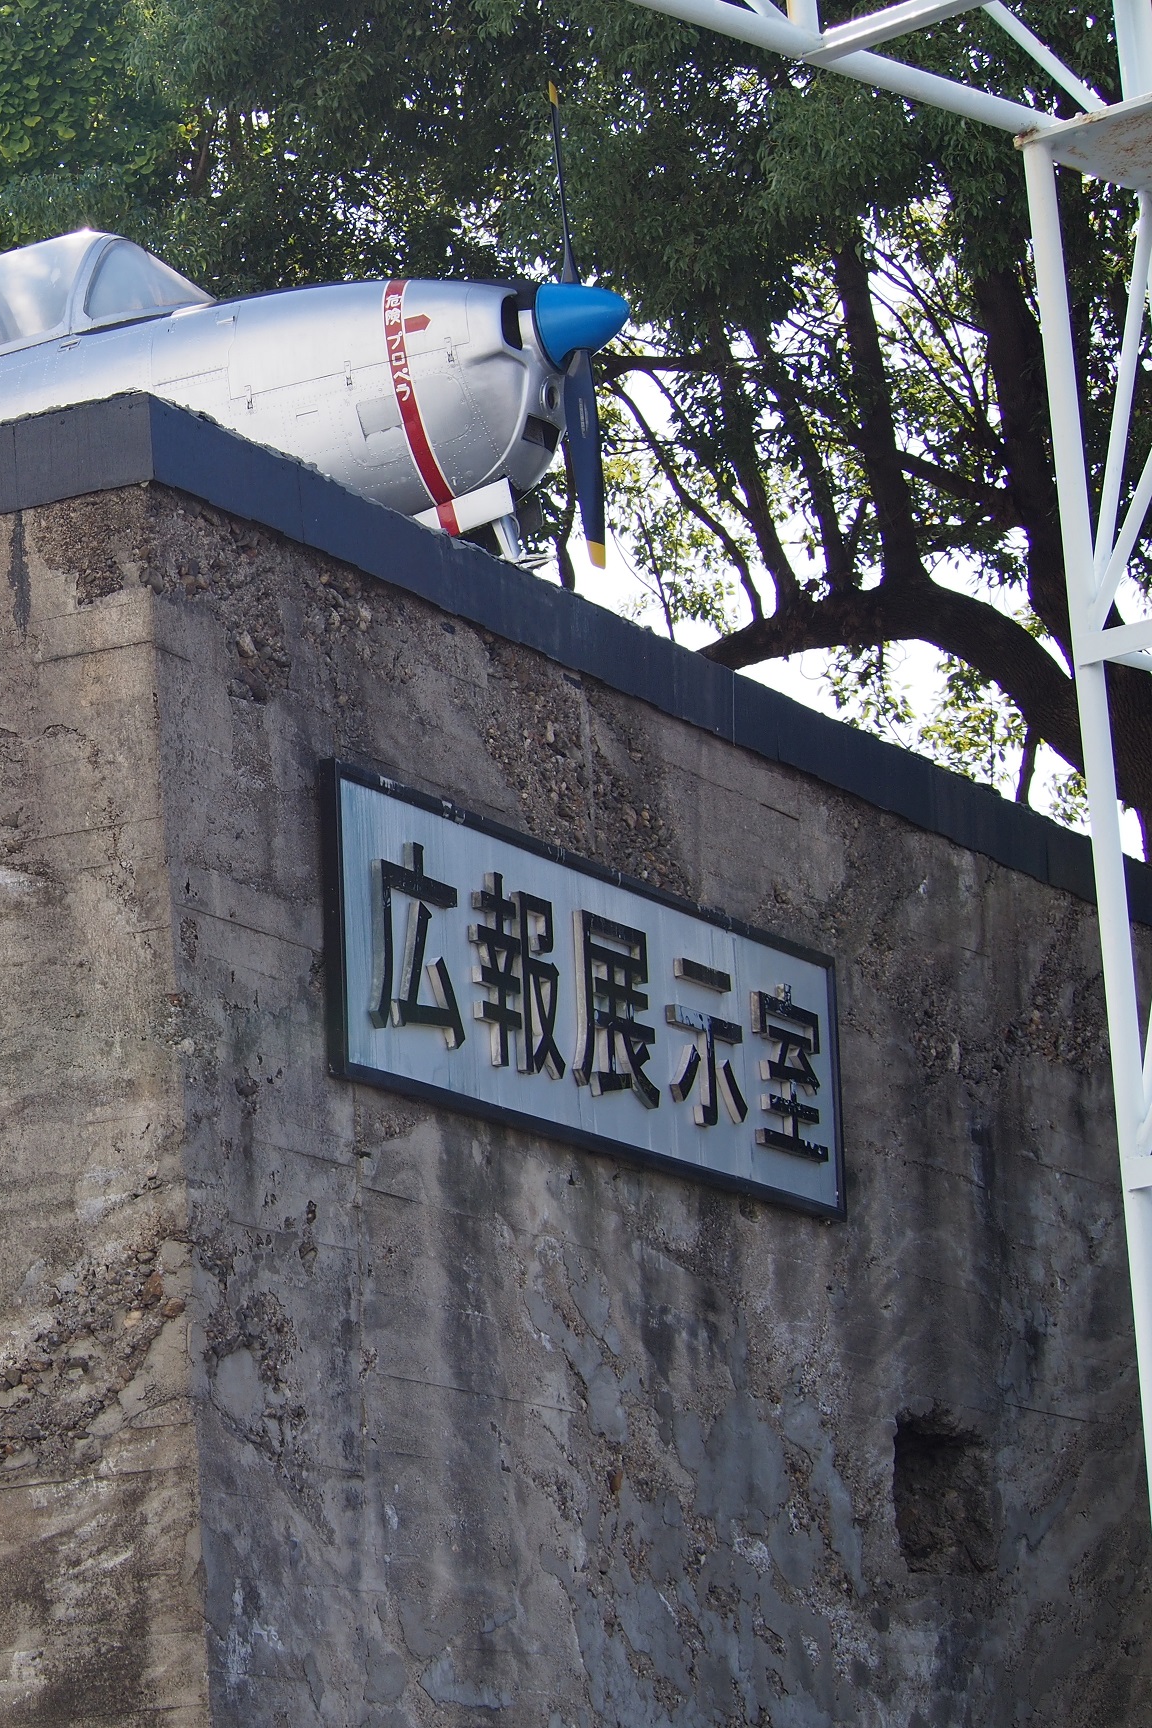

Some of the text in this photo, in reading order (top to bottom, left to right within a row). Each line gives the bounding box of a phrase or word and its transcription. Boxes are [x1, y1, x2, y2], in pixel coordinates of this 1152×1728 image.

[368, 842, 829, 1163] 広報展示室
